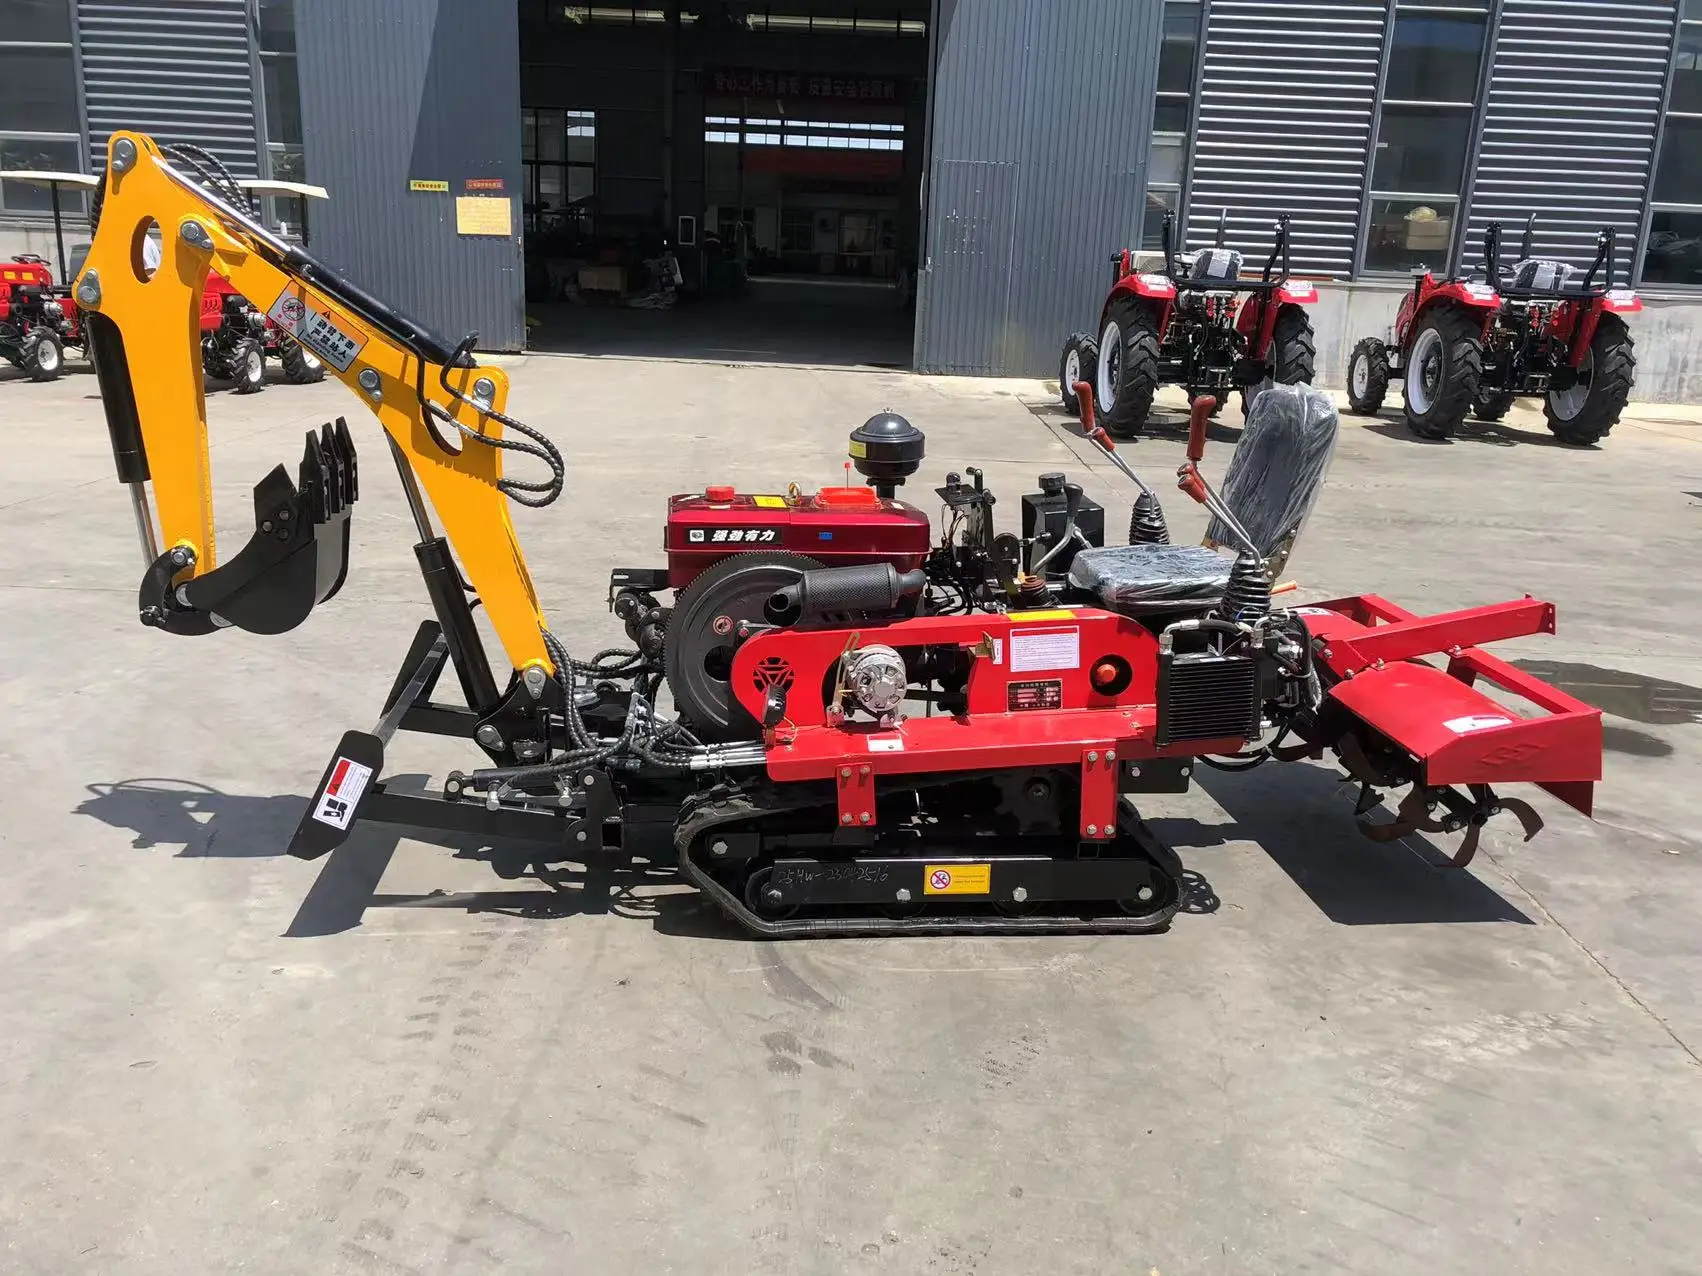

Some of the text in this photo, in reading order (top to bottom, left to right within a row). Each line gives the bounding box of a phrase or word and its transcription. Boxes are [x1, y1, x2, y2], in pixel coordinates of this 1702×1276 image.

[310, 327, 350, 359] 严禁站人
[712, 529, 775, 542] 强劲有力
